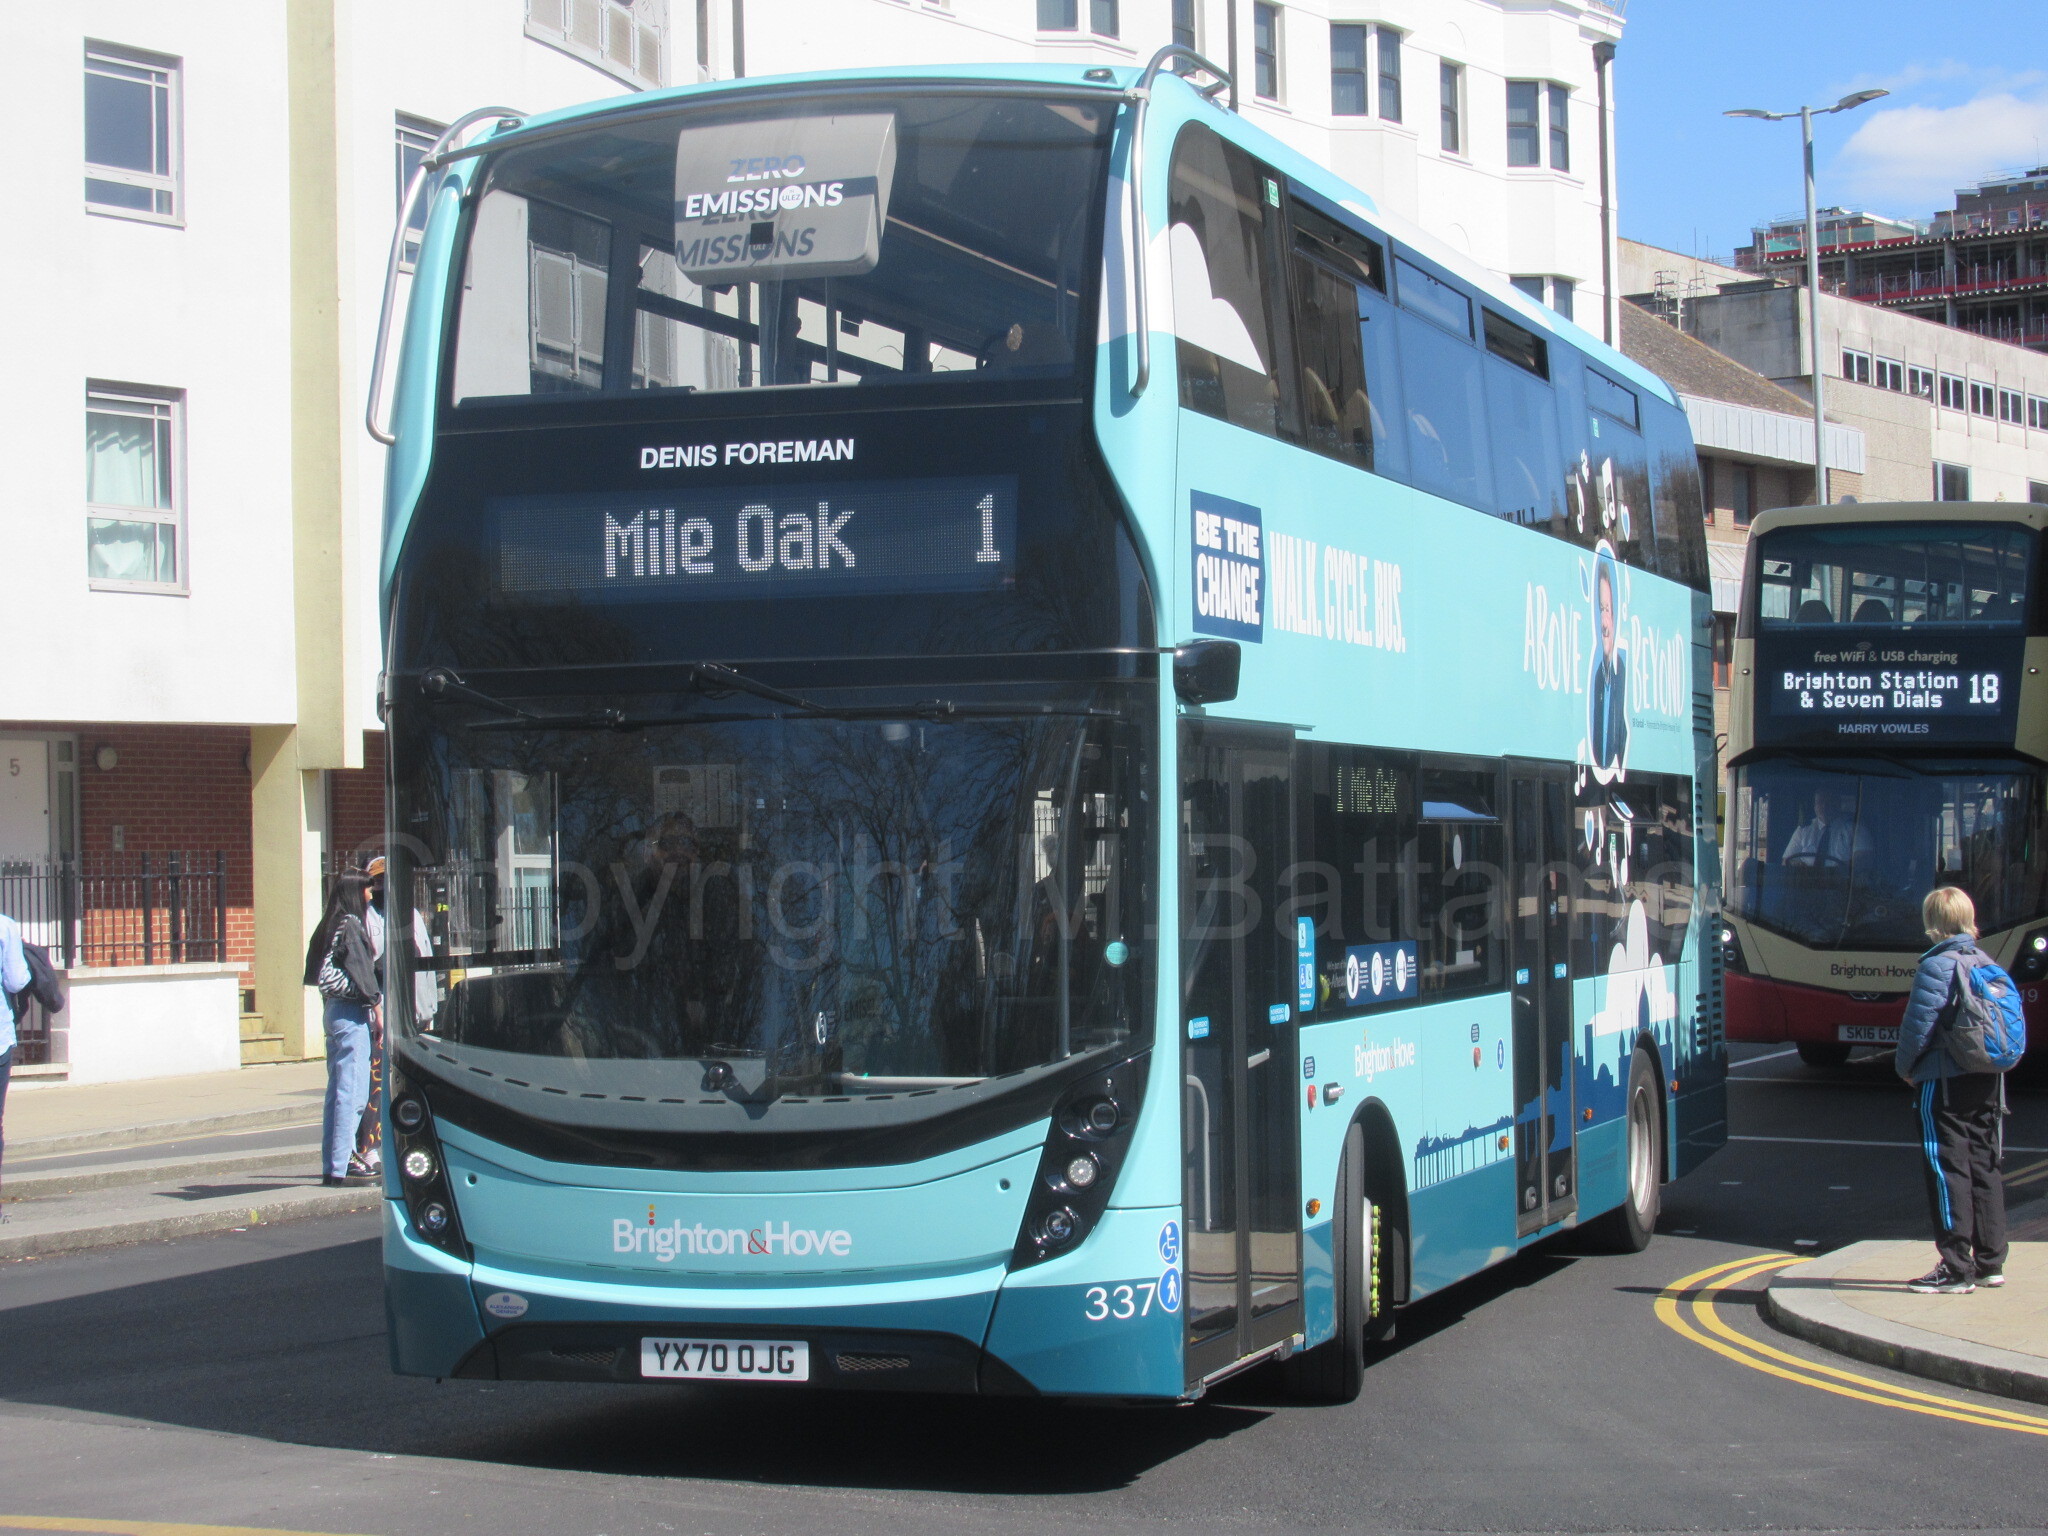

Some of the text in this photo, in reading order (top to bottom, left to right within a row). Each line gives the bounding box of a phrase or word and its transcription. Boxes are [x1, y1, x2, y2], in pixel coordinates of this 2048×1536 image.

[727, 154, 806, 183] ZERO
[685, 182, 844, 218] EMISSIONS
[640, 438, 855, 469] DENIS FOREMAN
[605, 493, 1001, 578] Mile Oak 1
[1195, 510, 1260, 560] BE THE
[1197, 552, 1260, 626] CHANGE
[1523, 581, 1583, 694] ABOVE
[1814, 650, 1958, 665] free WiFi & USB charging
[1783, 671, 1999, 704] Brighton Station 18
[1800, 690, 1943, 709] & Seven Dials
[1838, 723, 1930, 734] HARRY VOWLES
[9, 757, 21, 777] 5
[1846, 1027, 1875, 1041] SK16
[1085, 1282, 1157, 1321] 337
[654, 1342, 795, 1375] YX70 OJG
